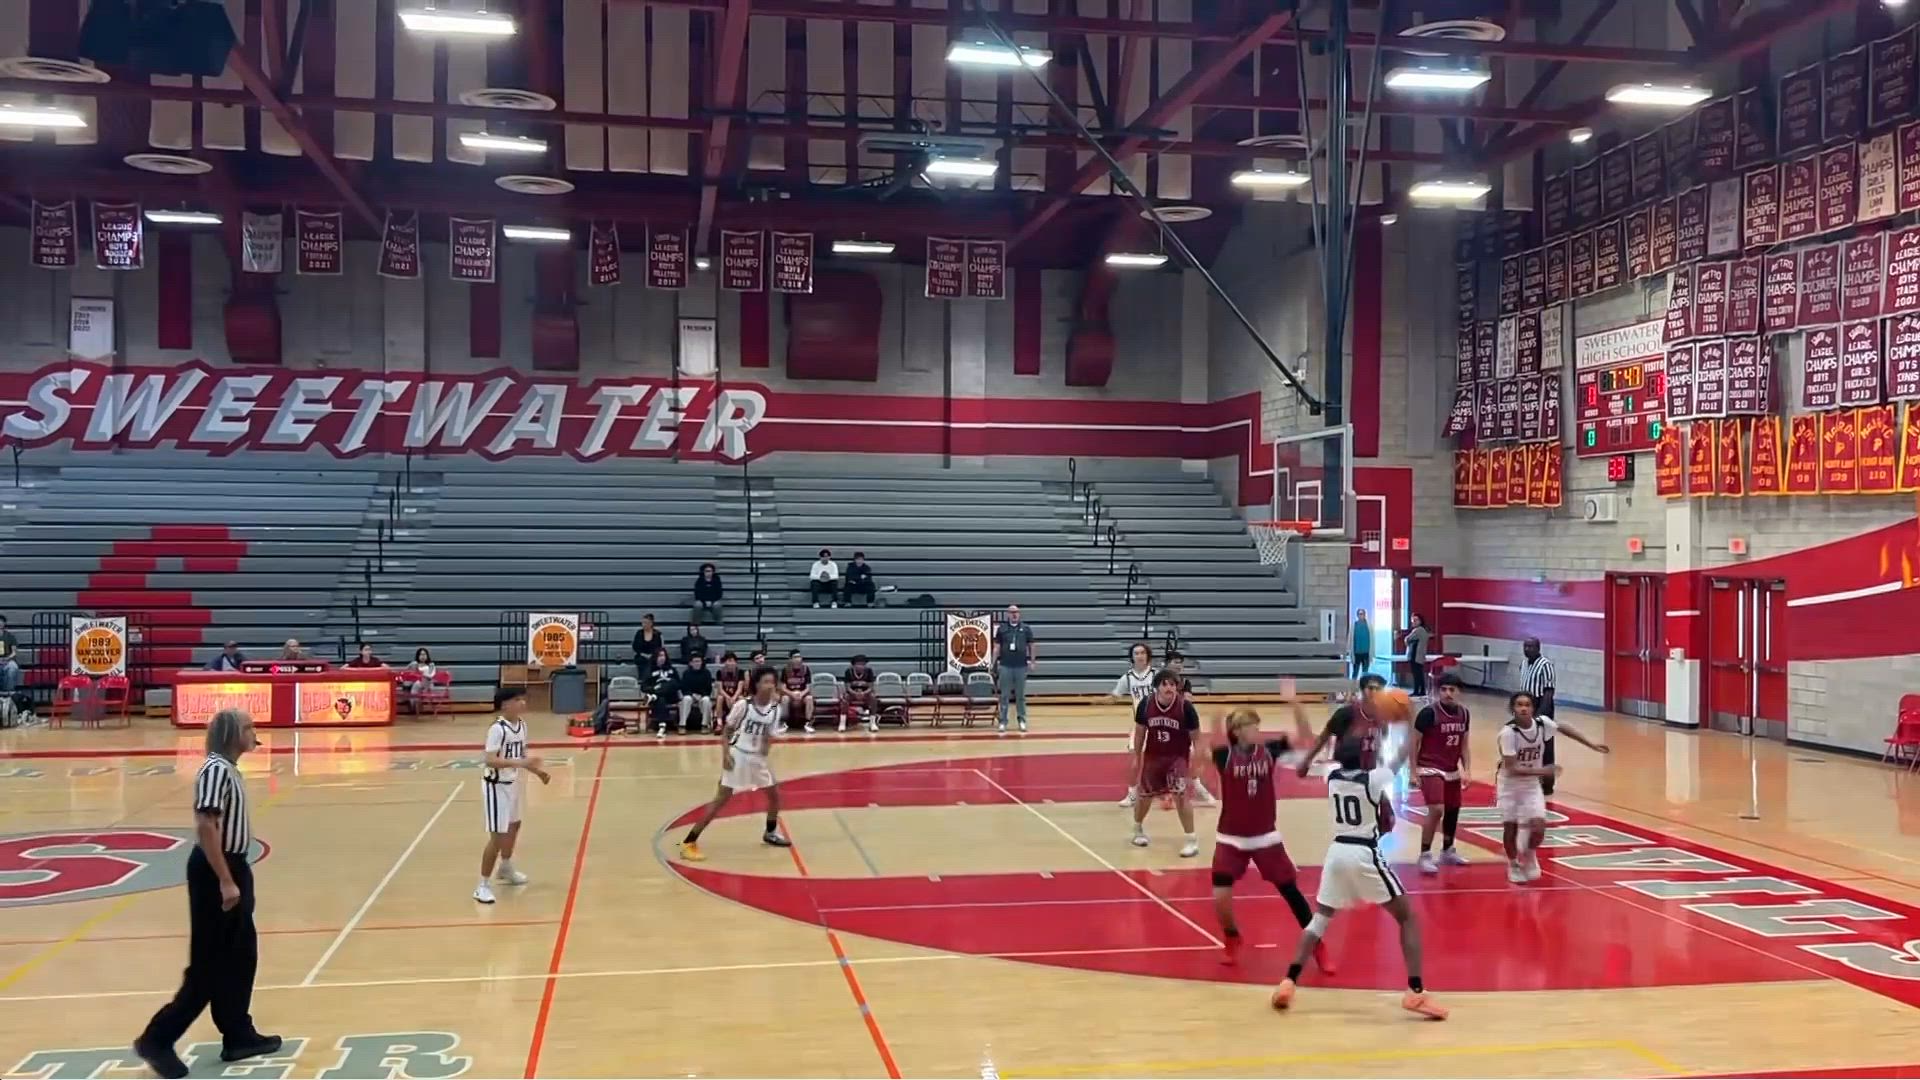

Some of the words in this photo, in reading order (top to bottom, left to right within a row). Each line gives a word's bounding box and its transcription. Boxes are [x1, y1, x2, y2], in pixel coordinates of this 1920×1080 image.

[1860, 156, 1894, 176] CHAMPS
[1821, 180, 1853, 200] CHAMPS
[1782, 196, 1814, 214] CHAMPS
[98, 231, 138, 242] CHAMPS
[301, 240, 338, 251] CHAMPS
[454, 245, 490, 256] CHAMPS
[1850, 242, 1874, 260] MESA
[650, 251, 684, 262] CHAMPS
[724, 256, 759, 268] CHAMPS
[775, 254, 810, 266] CHAMPS
[969, 264, 1001, 274] CHAMPS
[1771, 258, 1794, 272] METRO
[1889, 258, 1920, 276] CHAMP
[1768, 272, 1794, 283] LEAGUE
[1844, 268, 1880, 286] CHAMPS
[1896, 284, 1919, 296] TRACK
[1698, 291, 1724, 305] CHAMPS
[1894, 296, 1917, 308] 2001
[1584, 322, 1660, 351] SWEETWATER
[1582, 349, 1611, 366] HIGH
[1614, 340, 1662, 359] SCHOOL
[1848, 340, 1872, 352] LEAGUE
[1890, 344, 1920, 360] CHAMP
[1806, 357, 1838, 372] CHAMPS
[1844, 350, 1878, 366] CHAMPS
[1644, 360, 1664, 374] VISITO
[1850, 366, 1871, 378] GIRLS
[1580, 372, 1596, 384] HOME
[1667, 373, 1692, 388] CHAMPS
[4, 367, 767, 460] SWEETWATER
[1582, 422, 1596, 431] FOULS
[1606, 418, 1622, 428] PLAYER
[1624, 416, 1638, 426] FOULS
[1588, 428, 1596, 447] 0
[1652, 422, 1660, 440] 0
[1608, 457, 1626, 479] 33
[74, 620, 123, 636] SWEETWATER
[531, 616, 576, 632] SWEETWATER
[1440, 723, 1466, 734] DEVILS
[1156, 730, 1171, 742] 13
[1446, 735, 1460, 746] 23
[1333, 793, 1362, 826] 10
